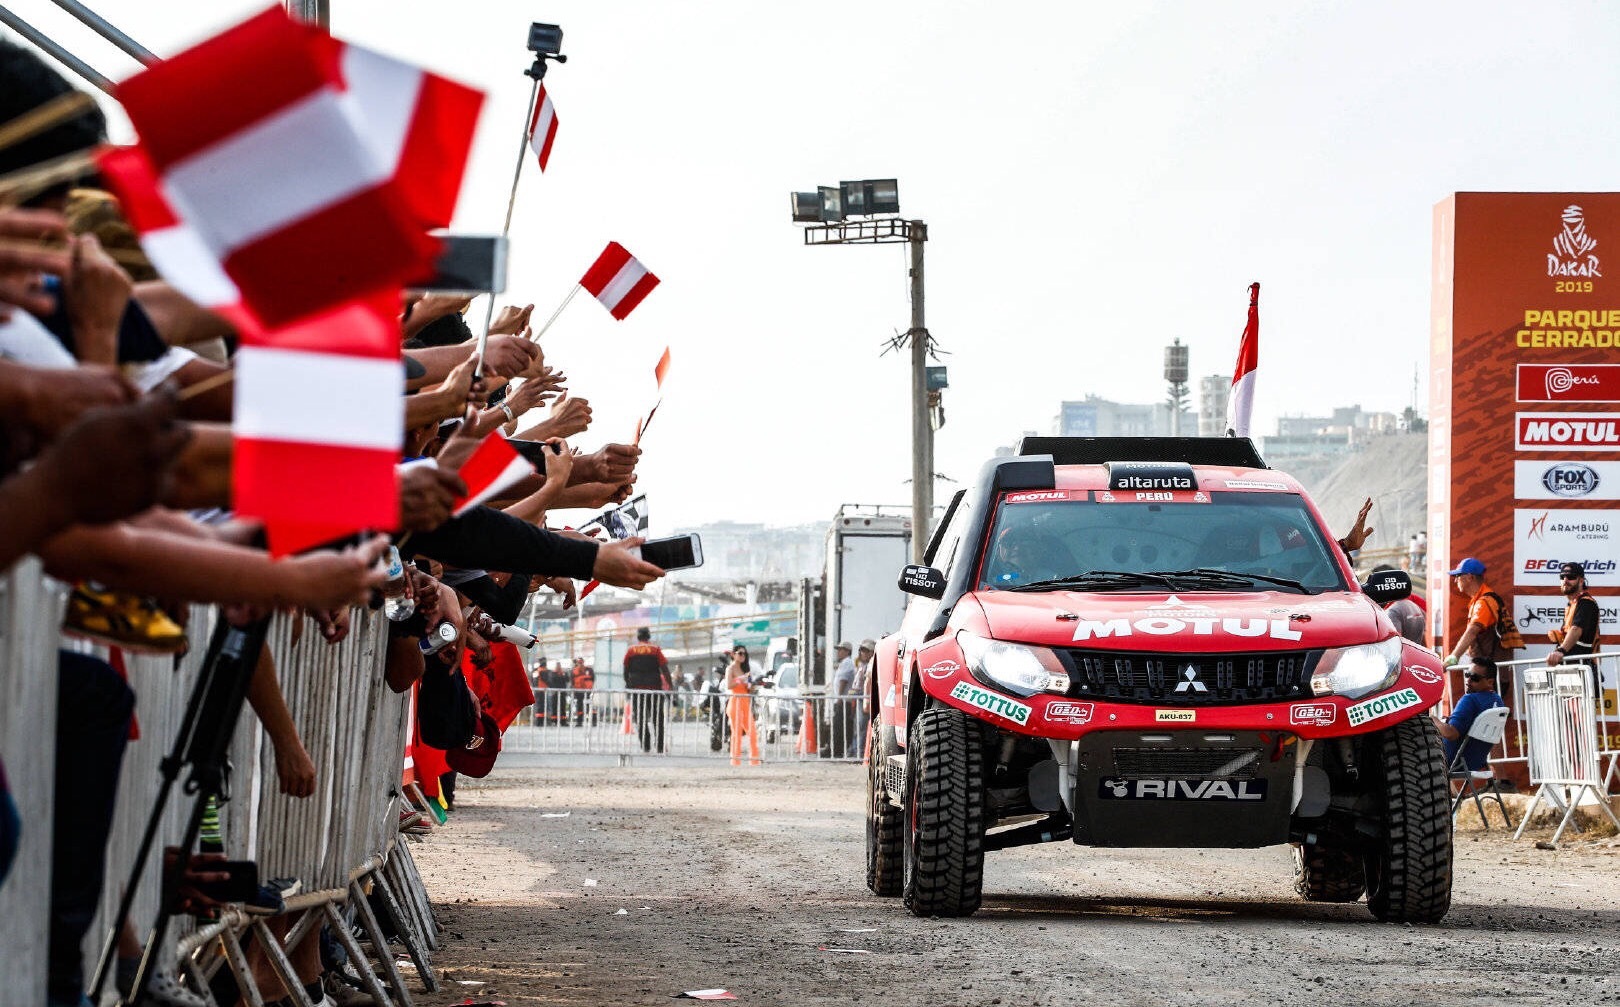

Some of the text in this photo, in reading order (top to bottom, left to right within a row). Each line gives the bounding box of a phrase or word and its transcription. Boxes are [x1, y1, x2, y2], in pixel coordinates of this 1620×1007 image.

[1547, 253, 1602, 277] DAKAR
[1556, 281, 1593, 292] 2019
[1524, 310, 1620, 328] PARQUE
[1545, 367, 1600, 400] Perú
[1523, 421, 1619, 442] MOTUL
[1118, 476, 1191, 488] altaruta
[1555, 470, 1587, 484] FOX
[1011, 491, 1065, 502] MOTUL
[1550, 523, 1609, 532] ARAMBURÚ
[905, 577, 937, 588] TISSOT
[1375, 582, 1407, 591] TISSOT
[1072, 617, 1302, 641] MOTUL
[969, 689, 1027, 722] TOTTUS
[1363, 690, 1418, 717] TOTTUS
[1135, 780, 1262, 800] RIVAL
